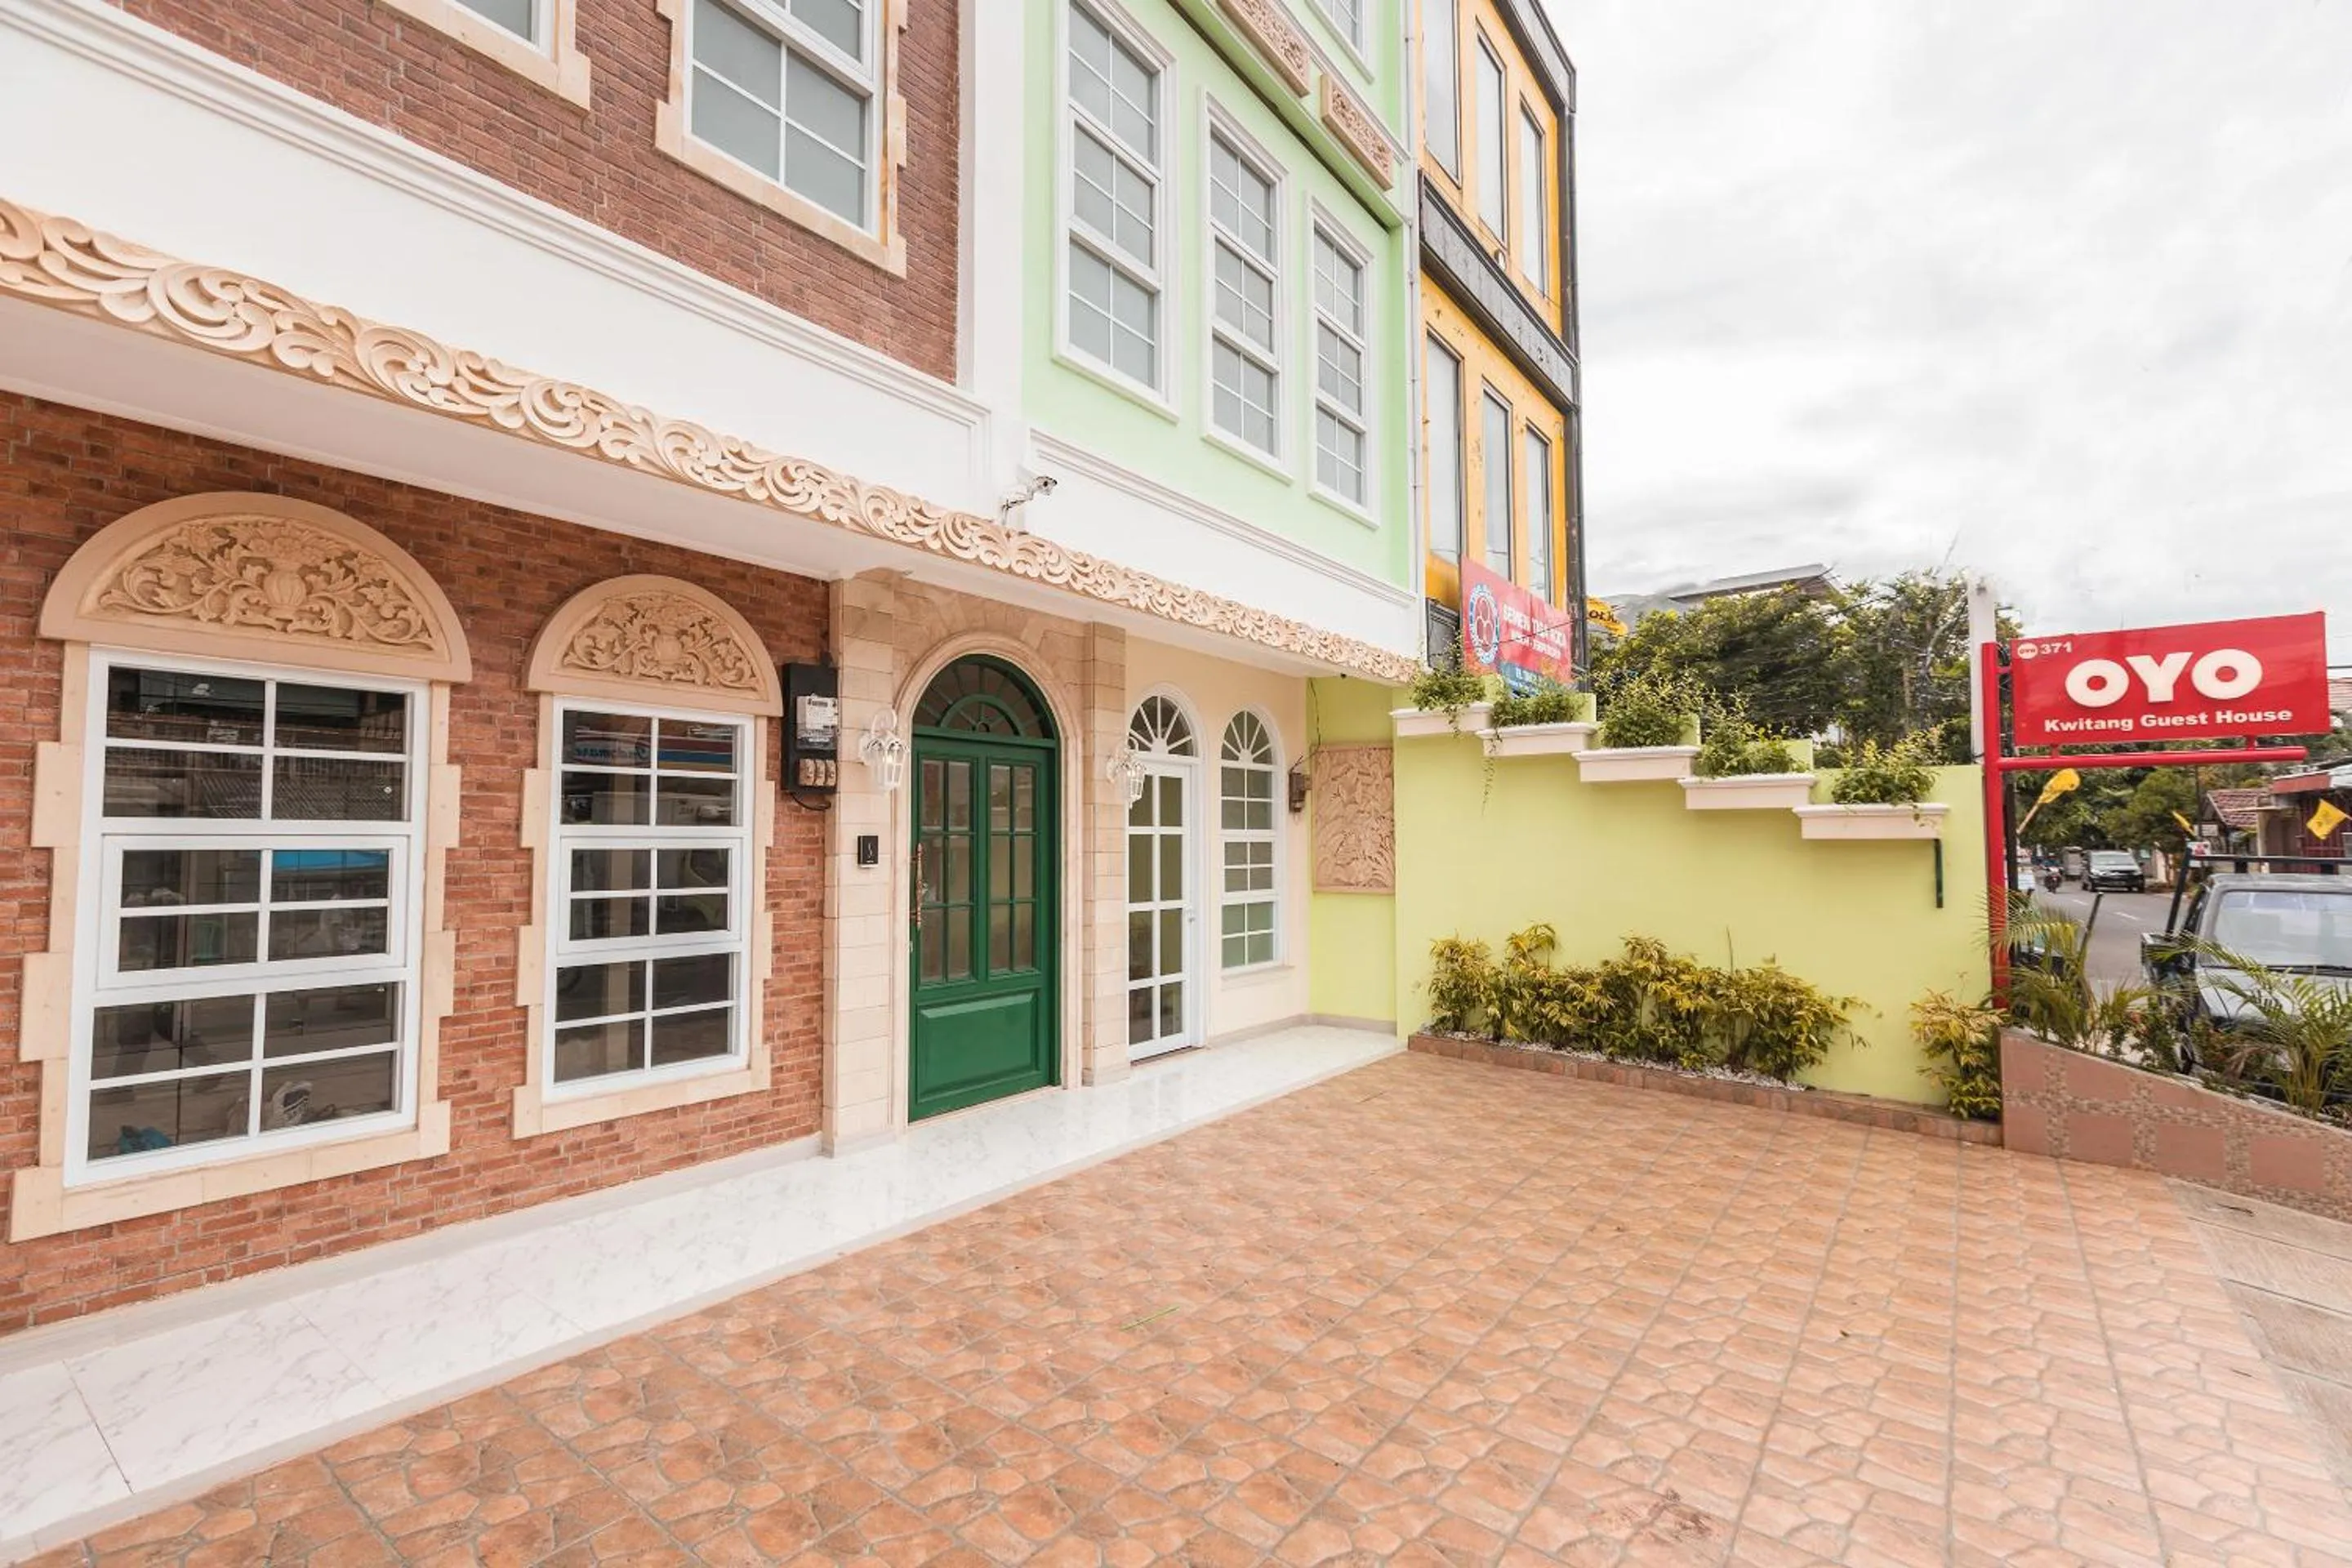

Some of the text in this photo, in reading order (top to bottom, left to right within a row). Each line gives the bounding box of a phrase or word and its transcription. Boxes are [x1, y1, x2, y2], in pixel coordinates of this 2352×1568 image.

[2040, 641, 2072, 655] 371
[2065, 648, 2263, 707] OYO
[2044, 709, 2293, 733] Kwitang Guest House
